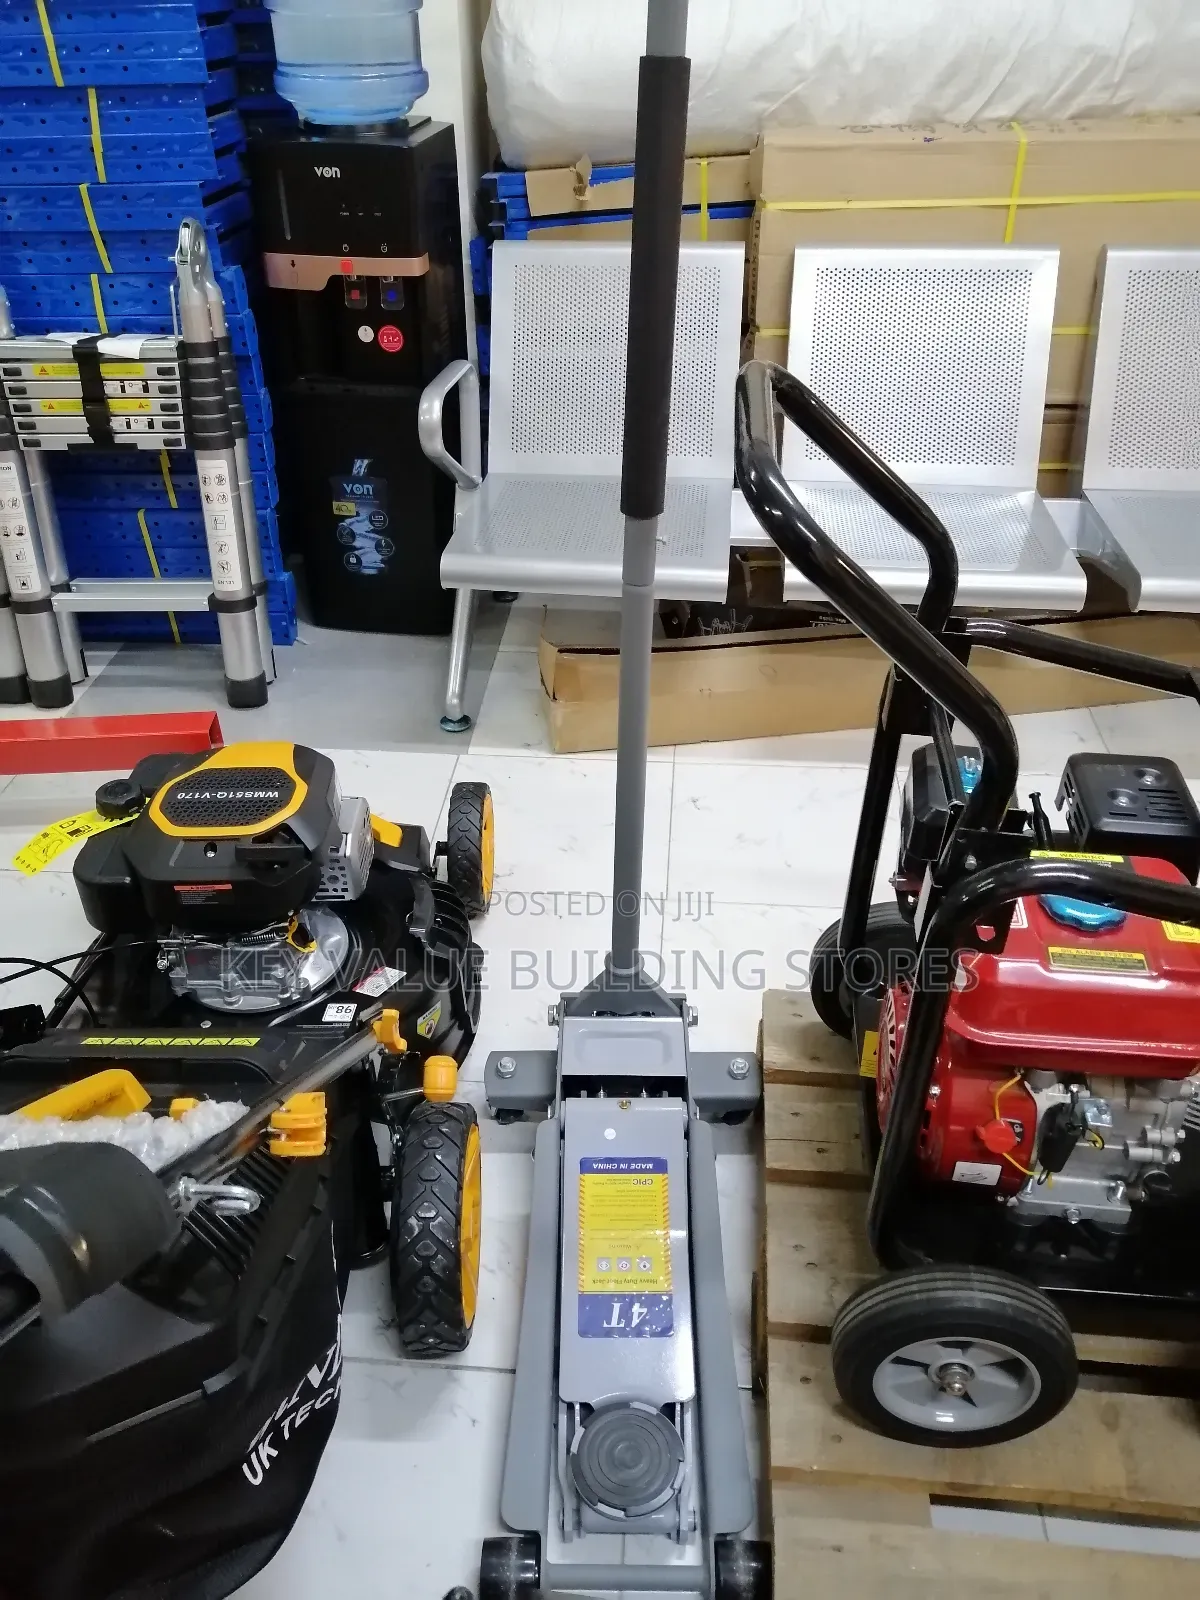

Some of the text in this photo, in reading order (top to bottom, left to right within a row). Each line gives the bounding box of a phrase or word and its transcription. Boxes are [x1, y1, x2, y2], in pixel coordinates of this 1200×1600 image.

[177, 791, 280, 799] WMS51Q-V170
[632, 1178, 654, 1186] CPIC
[602, 1302, 649, 1329] 4T
[241, 1431, 279, 1486] UK
